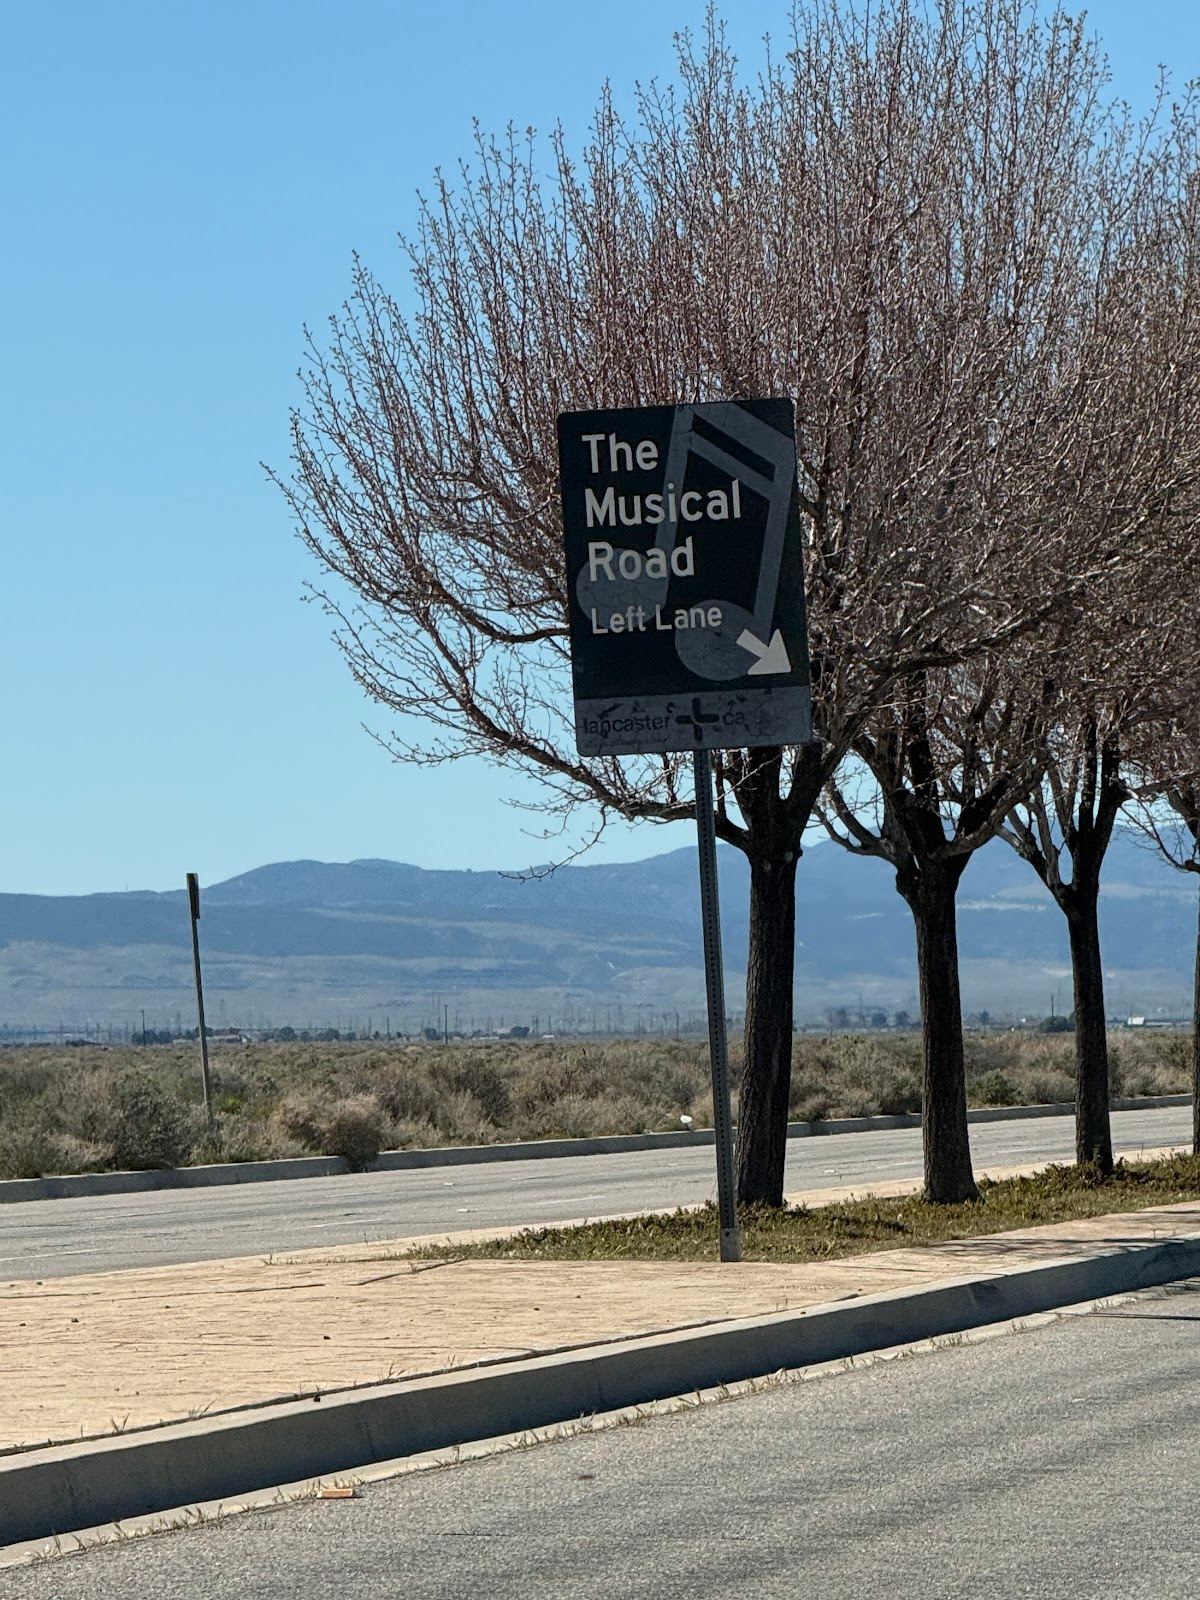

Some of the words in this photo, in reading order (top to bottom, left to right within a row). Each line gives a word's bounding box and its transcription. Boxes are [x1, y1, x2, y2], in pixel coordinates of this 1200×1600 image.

[581, 432, 659, 474] The
[584, 479, 742, 528] Musical
[587, 536, 696, 582] Road
[590, 606, 647, 635] Left
[655, 604, 723, 631] Lane
[582, 714, 671, 735] lancaster
